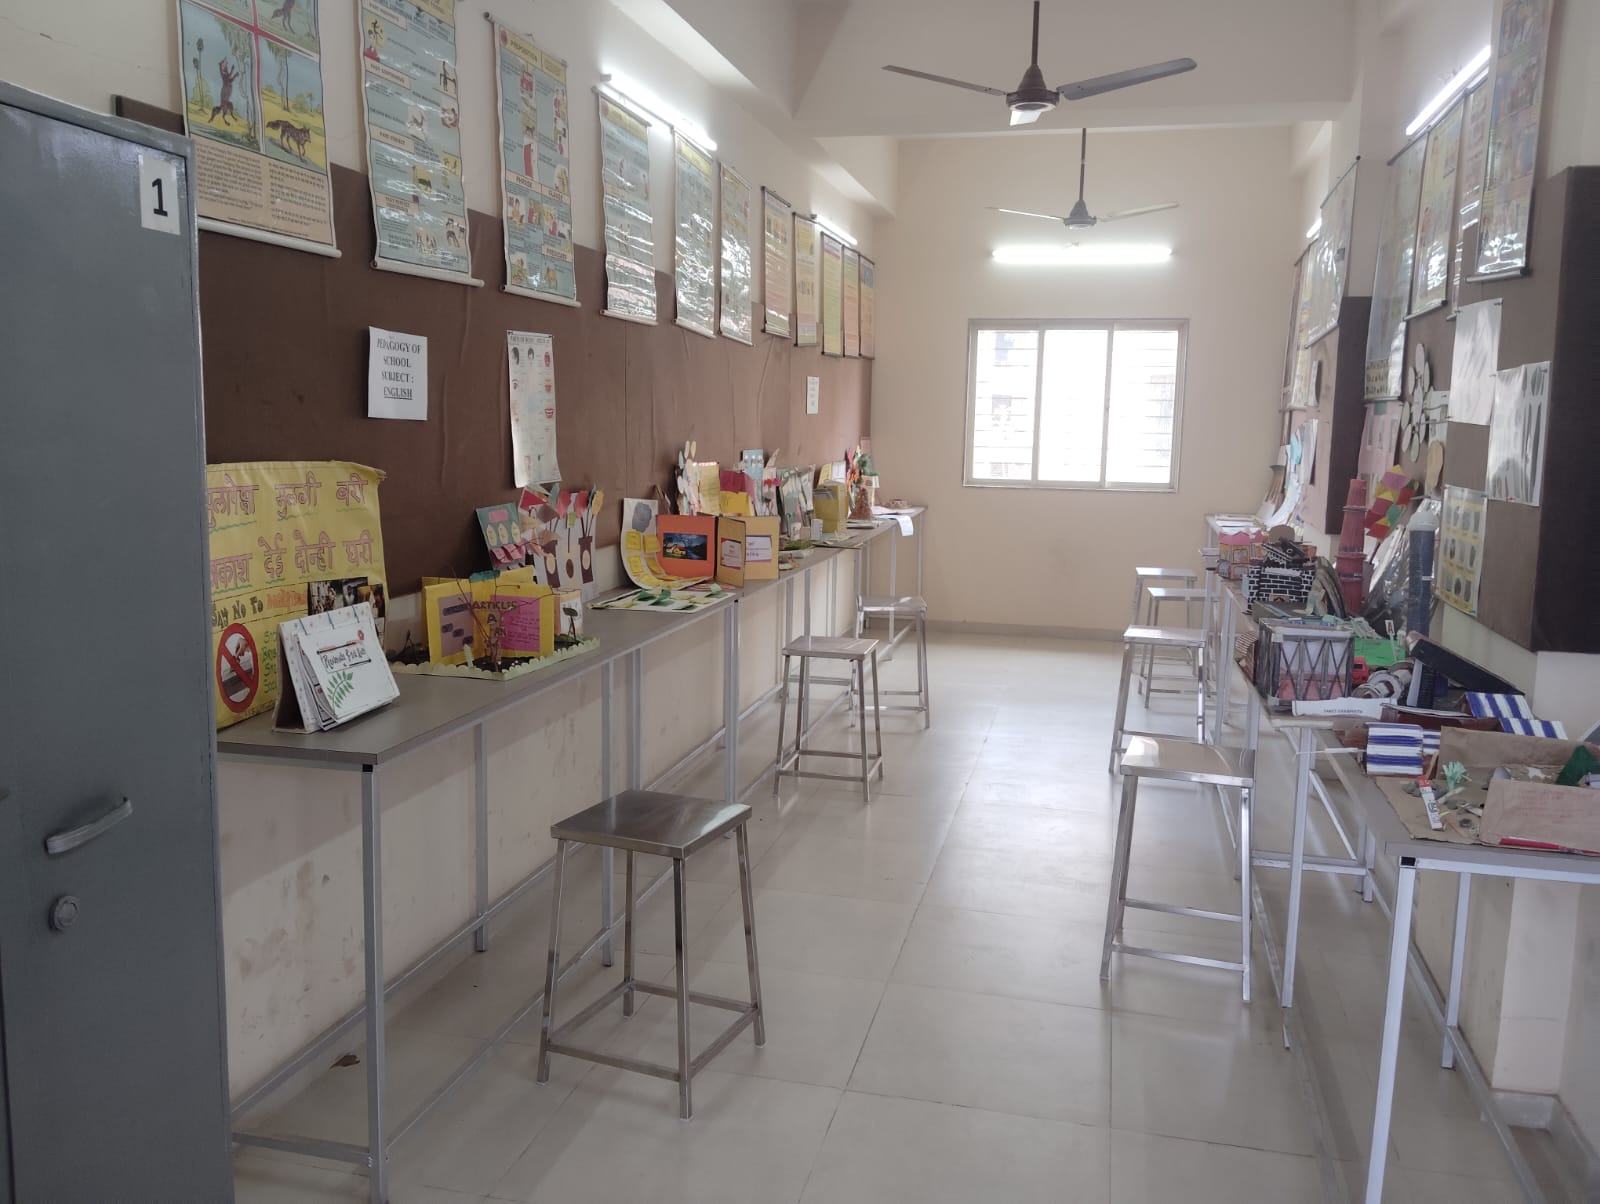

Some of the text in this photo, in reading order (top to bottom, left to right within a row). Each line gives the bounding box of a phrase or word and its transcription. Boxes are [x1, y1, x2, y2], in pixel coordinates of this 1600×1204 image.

[152, 178, 168, 217] 1
[376, 338, 421, 354] PEDAGOGY OF
[383, 355, 412, 368] SCHOOL
[381, 370, 409, 383] SUBJECT
[383, 386, 413, 399] ENGLISH
